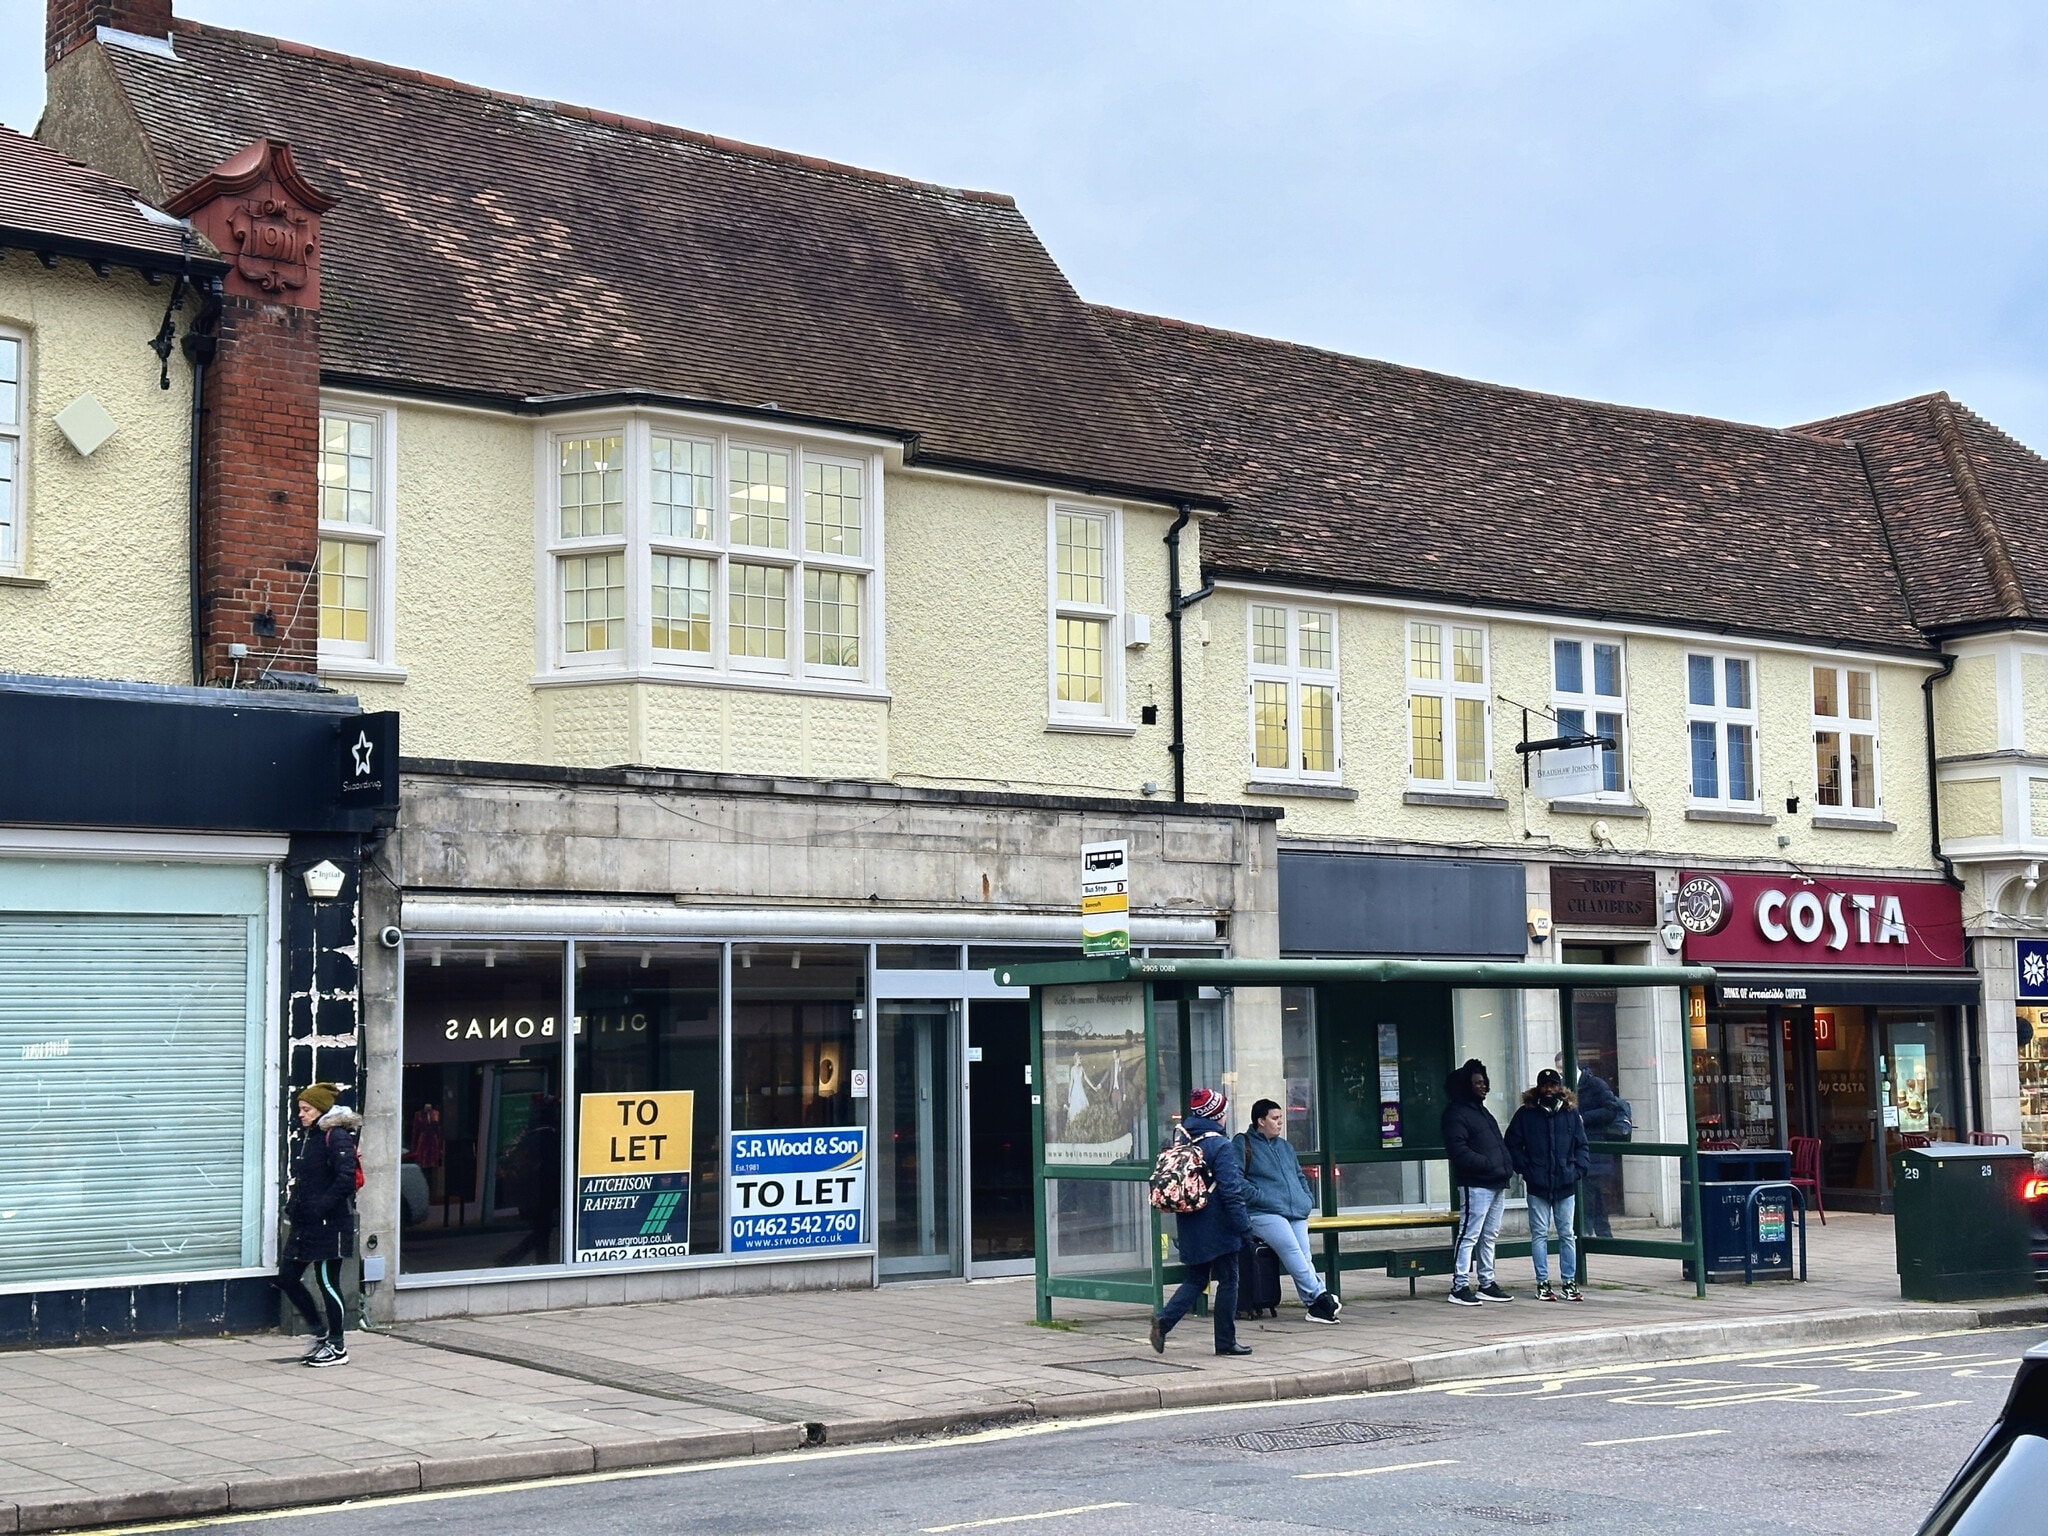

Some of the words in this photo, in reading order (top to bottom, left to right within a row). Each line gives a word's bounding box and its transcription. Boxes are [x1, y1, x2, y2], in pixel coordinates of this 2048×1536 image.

[1117, 882, 1124, 892] D
[1583, 879, 1628, 895] CROFT
[1684, 880, 1715, 897] COSTA
[1568, 899, 1642, 915] CHAMBERS
[1681, 911, 1719, 930] COFFEE
[1754, 889, 1910, 951] COSTA
[1669, 932, 1683, 941] MPS
[1142, 964, 1158, 972] 2905
[1748, 988, 1784, 999] irresistible
[1785, 988, 1807, 999] COFFEE
[1818, 1080, 1829, 1095] by
[1832, 1082, 1865, 1094] COSTA
[617, 1099, 659, 1126] TO
[611, 1135, 667, 1162] LET
[736, 1140, 766, 1158] S.R.
[767, 1137, 812, 1157] Wood
[814, 1137, 827, 1155] &
[829, 1137, 858, 1154] Son
[1905, 1168, 1919, 1179] 29
[1982, 1165, 1992, 1176] 29
[584, 1177, 653, 1193] AITCHISON
[736, 1180, 785, 1208] TO
[795, 1177, 856, 1206] LET
[583, 1196, 640, 1212] RAFFETY
[1722, 1195, 1746, 1204] LITTER
[733, 1218, 787, 1238] 01462
[790, 1215, 822, 1235] 542
[825, 1213, 856, 1232] 760
[595, 1233, 672, 1248] www.argroup.co.uk
[746, 1233, 842, 1248] www.srwood.co.uk
[582, 1249, 628, 1262] 01462
[632, 1245, 686, 1260] 413999
